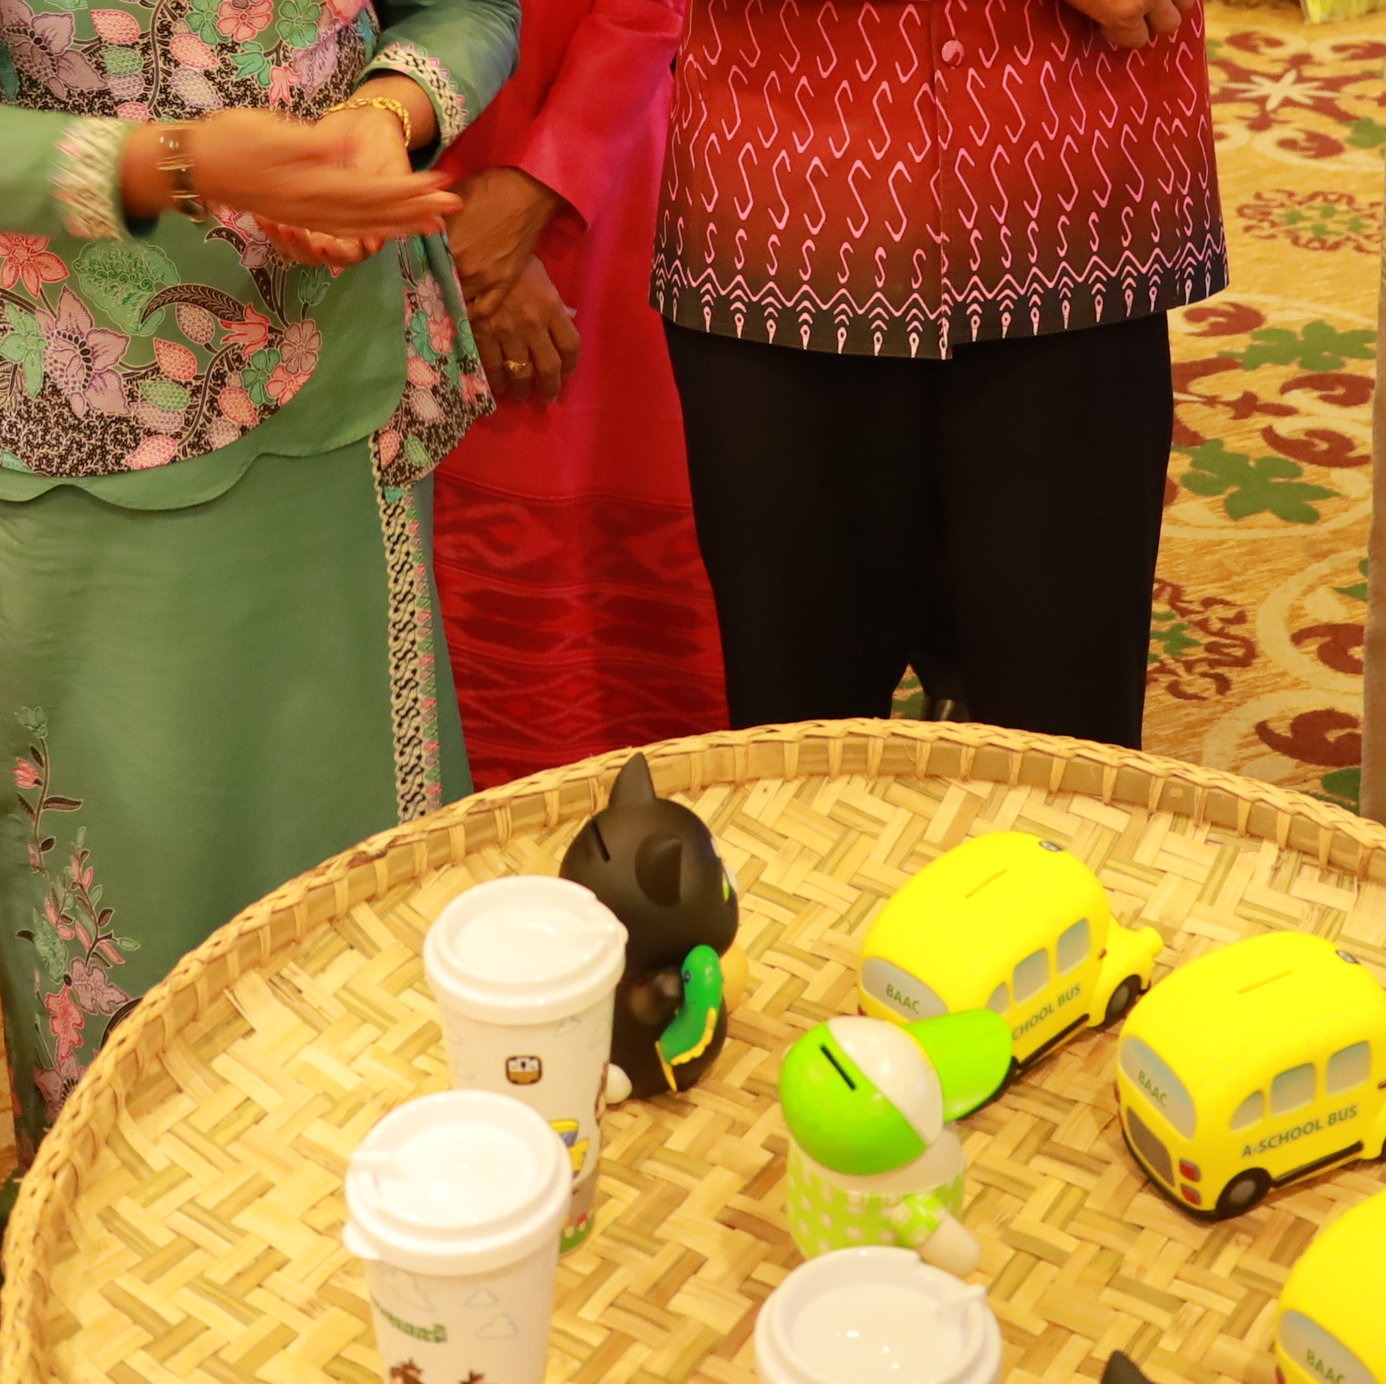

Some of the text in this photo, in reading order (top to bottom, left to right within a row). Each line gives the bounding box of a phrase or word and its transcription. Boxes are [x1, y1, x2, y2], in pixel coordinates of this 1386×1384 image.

[886, 984, 921, 1014] BAAC
[1012, 983, 1082, 1040] CHOOL BUS
[1137, 1069, 1168, 1109] BAAC
[1242, 1104, 1358, 1159] A-SCHOOL BUS
